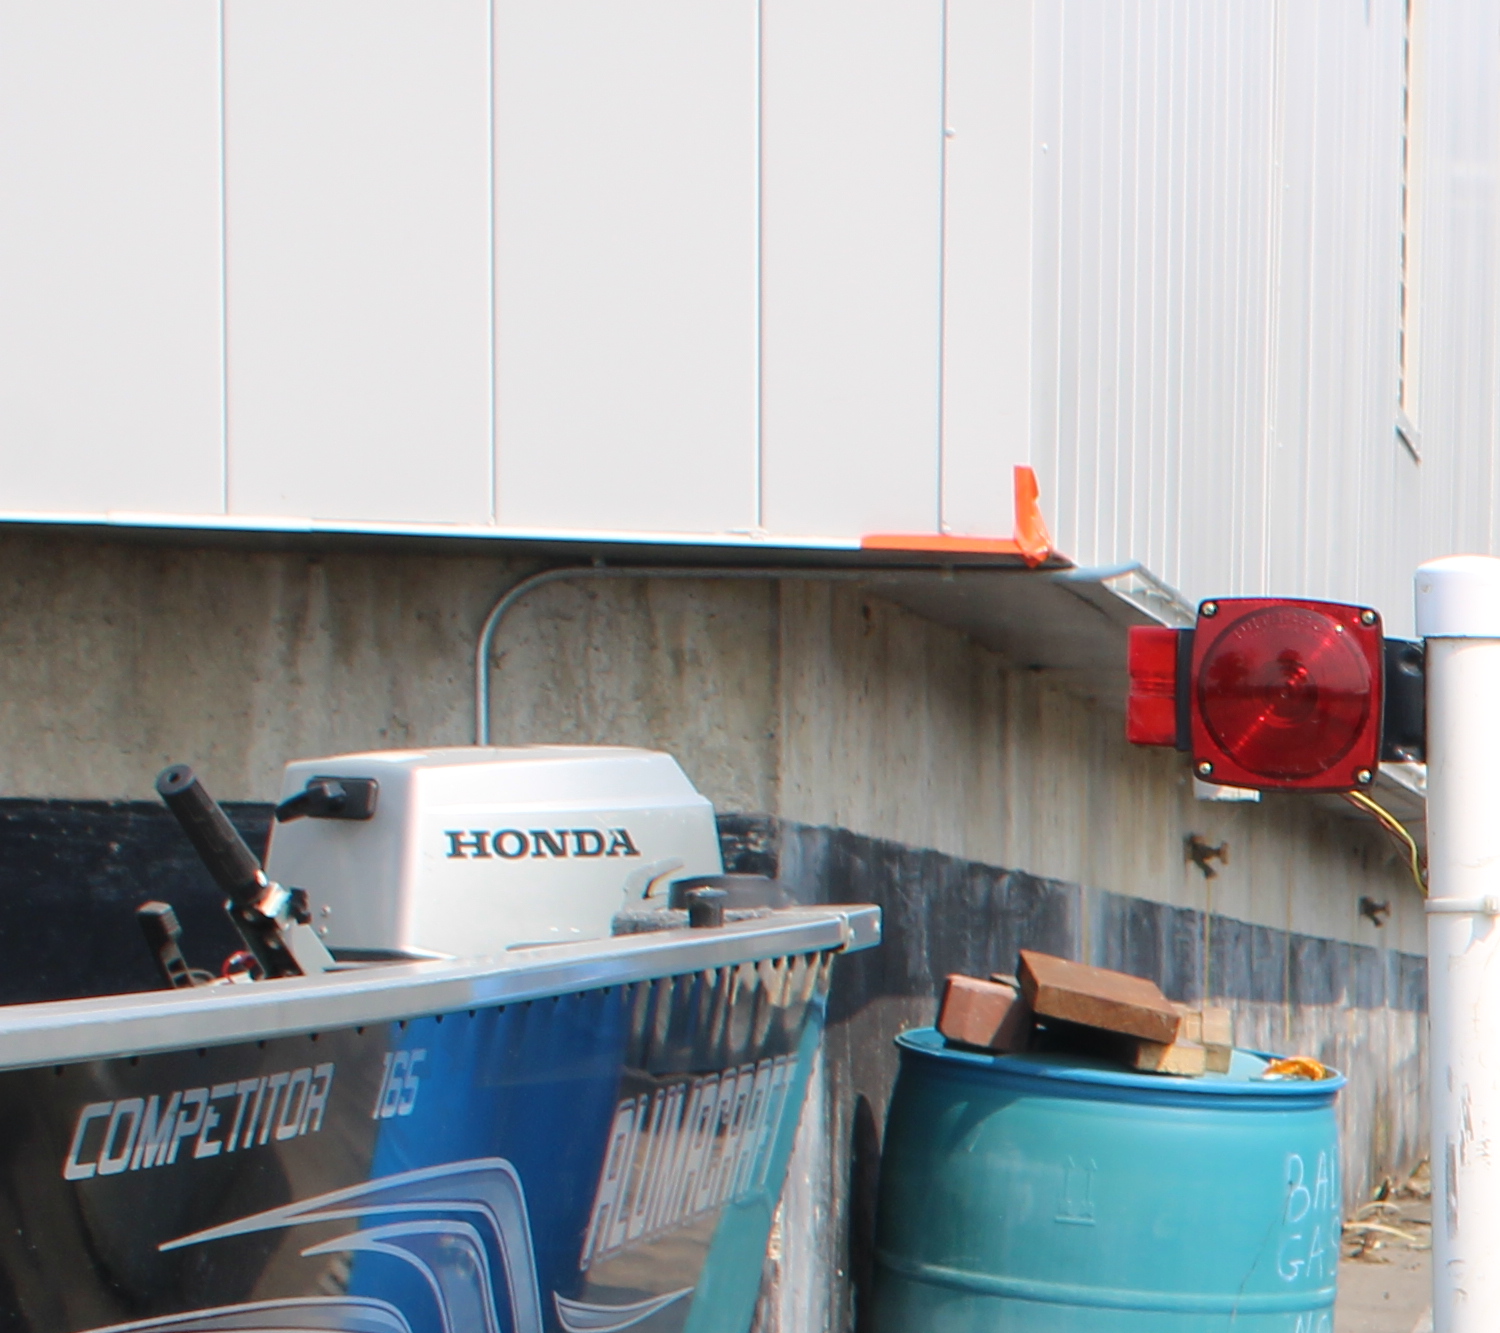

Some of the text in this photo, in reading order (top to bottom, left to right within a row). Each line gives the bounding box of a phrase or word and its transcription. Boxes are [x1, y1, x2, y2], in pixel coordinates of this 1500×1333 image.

[445, 828, 641, 860] HONDA
[63, 1049, 427, 1181] COMPETITOR 165
[580, 1052, 799, 1272] ALUMACRAFT
